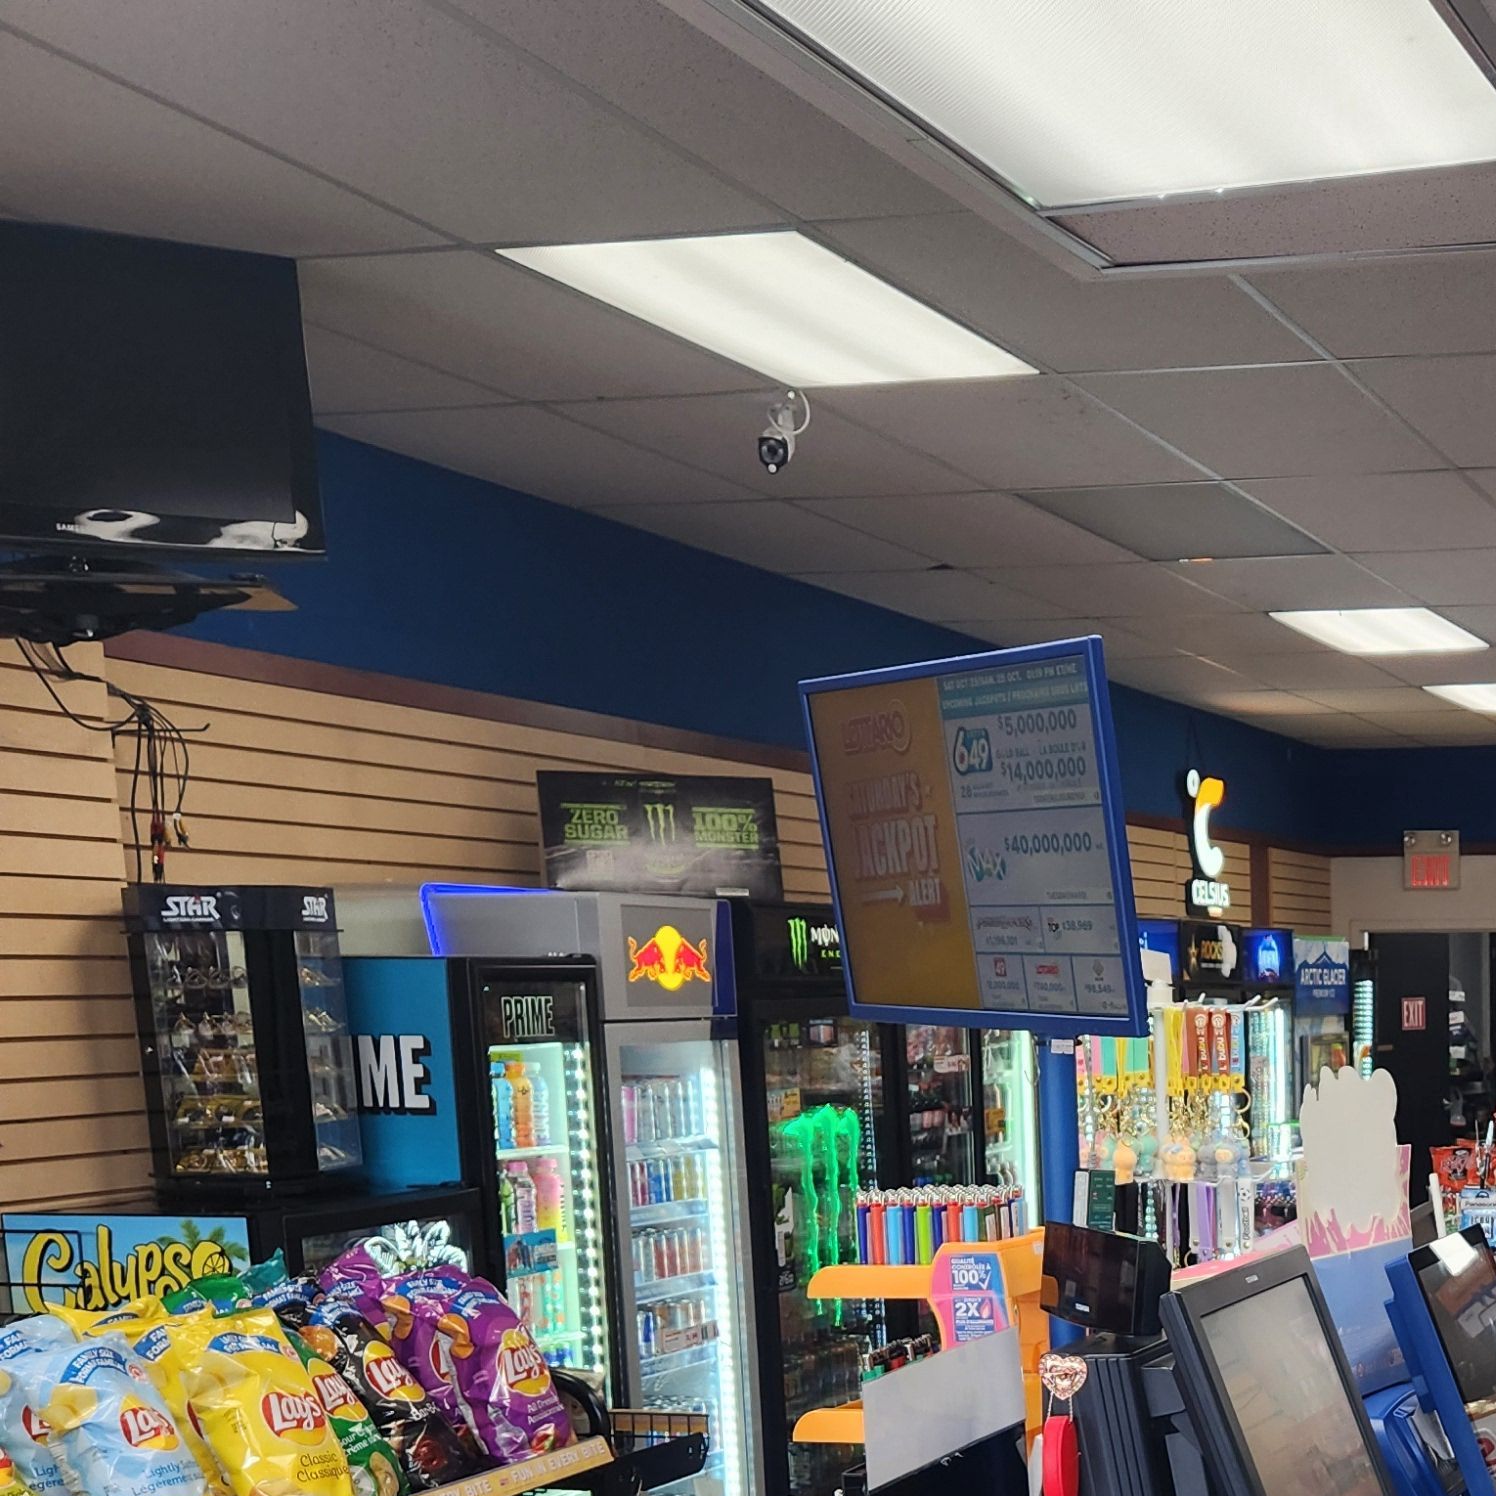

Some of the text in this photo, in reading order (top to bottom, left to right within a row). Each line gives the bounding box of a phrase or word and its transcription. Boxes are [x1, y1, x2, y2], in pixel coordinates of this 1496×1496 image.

[1001, 756, 1086, 784] $14,000,000
[570, 809, 619, 825] ZERO
[693, 813, 758, 832] 100%
[564, 824, 629, 840] SUGAR
[1004, 831, 1091, 856] $40,000,000
[1191, 880, 1230, 907] CELSIUS
[161, 896, 220, 920] STAR
[301, 896, 328, 920] STAR
[502, 996, 554, 1039] PRIME
[1403, 999, 1424, 1027] EXIT
[22, 1224, 233, 1314] Calypso
[955, 1303, 979, 1317] 2X
[270, 1390, 321, 1431] Lay's
[300, 1452, 338, 1468] Classic
[511, 1466, 533, 1483] FUN
[549, 1453, 581, 1475] EVERY
[584, 1443, 606, 1462] BITE
[296, 1465, 350, 1483] Classique
